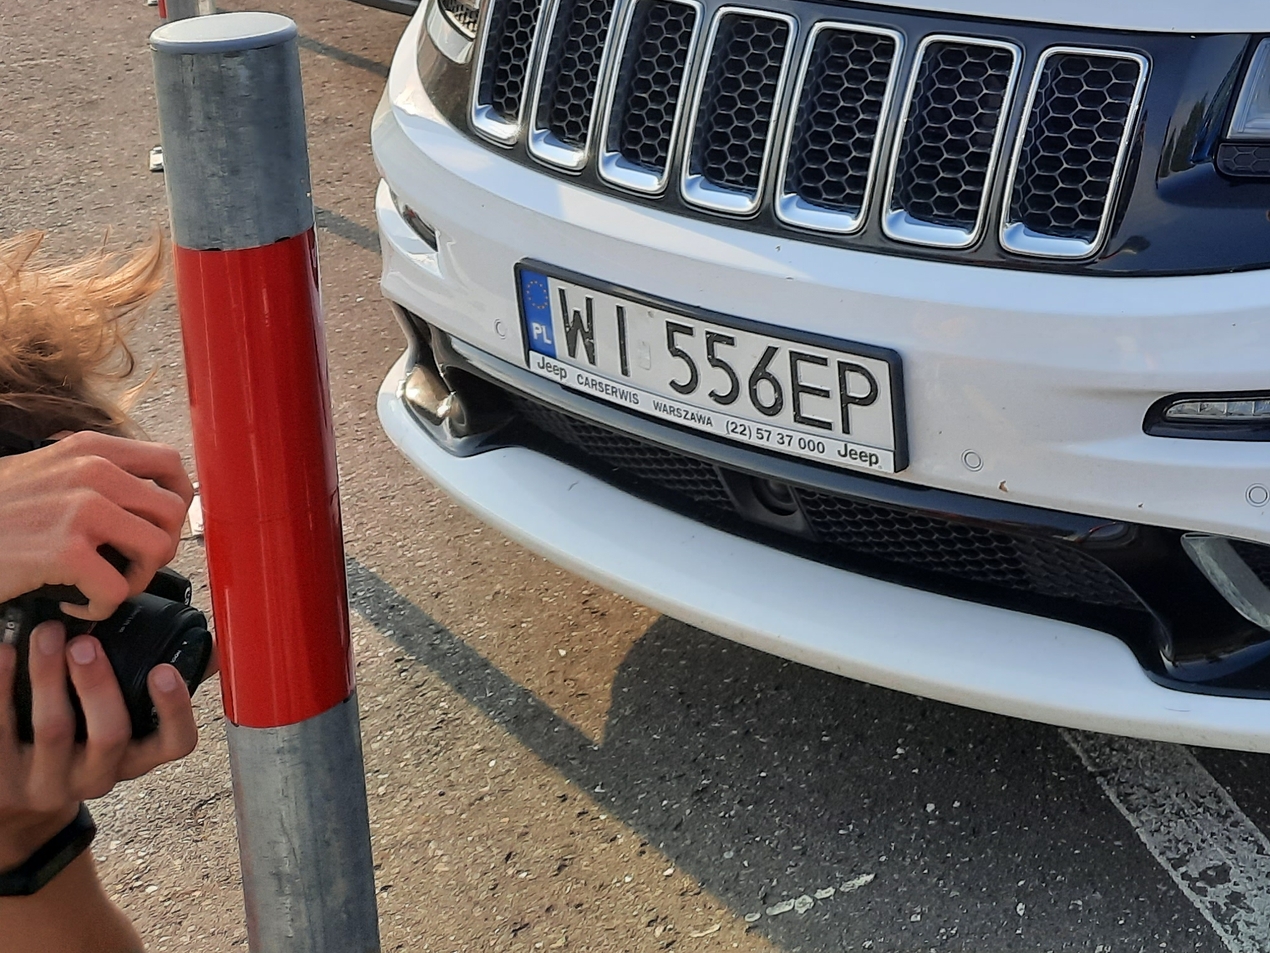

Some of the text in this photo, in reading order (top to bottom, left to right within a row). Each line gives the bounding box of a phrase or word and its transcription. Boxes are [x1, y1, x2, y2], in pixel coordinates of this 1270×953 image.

[533, 322, 552, 345] PL
[557, 286, 879, 435] WI 556EP
[537, 356, 879, 467] Jeep CARSERWIS WARSZAWA (22) 57 37 000 Jeep
